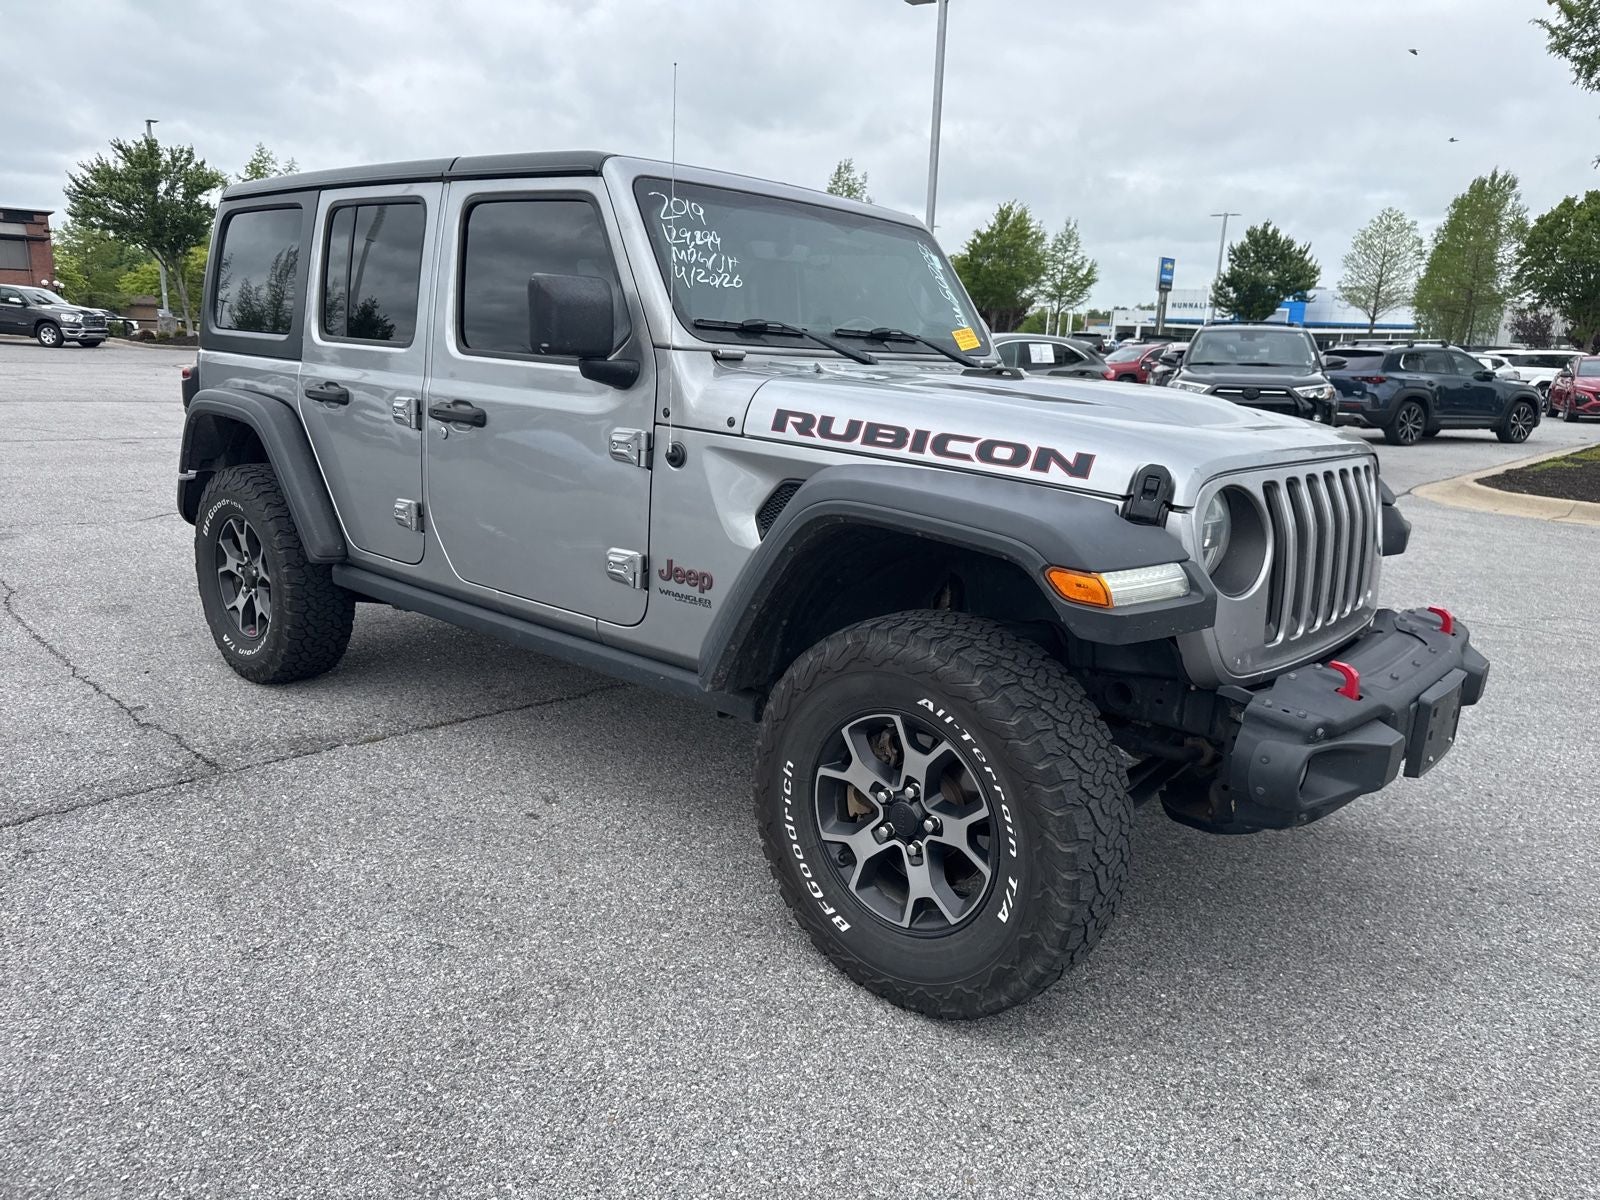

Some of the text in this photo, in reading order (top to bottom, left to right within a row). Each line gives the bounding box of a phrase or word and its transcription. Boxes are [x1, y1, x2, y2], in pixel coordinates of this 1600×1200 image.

[648, 192, 706, 225] 2019
[771, 408, 1096, 480] RUBICON
[202, 498, 244, 537] BFGoodrich
[658, 559, 713, 594] Jeep
[659, 587, 712, 605] WRANGLER
[917, 698, 1018, 924] All-Terrain T/A
[781, 760, 852, 933] BFGoodrich
